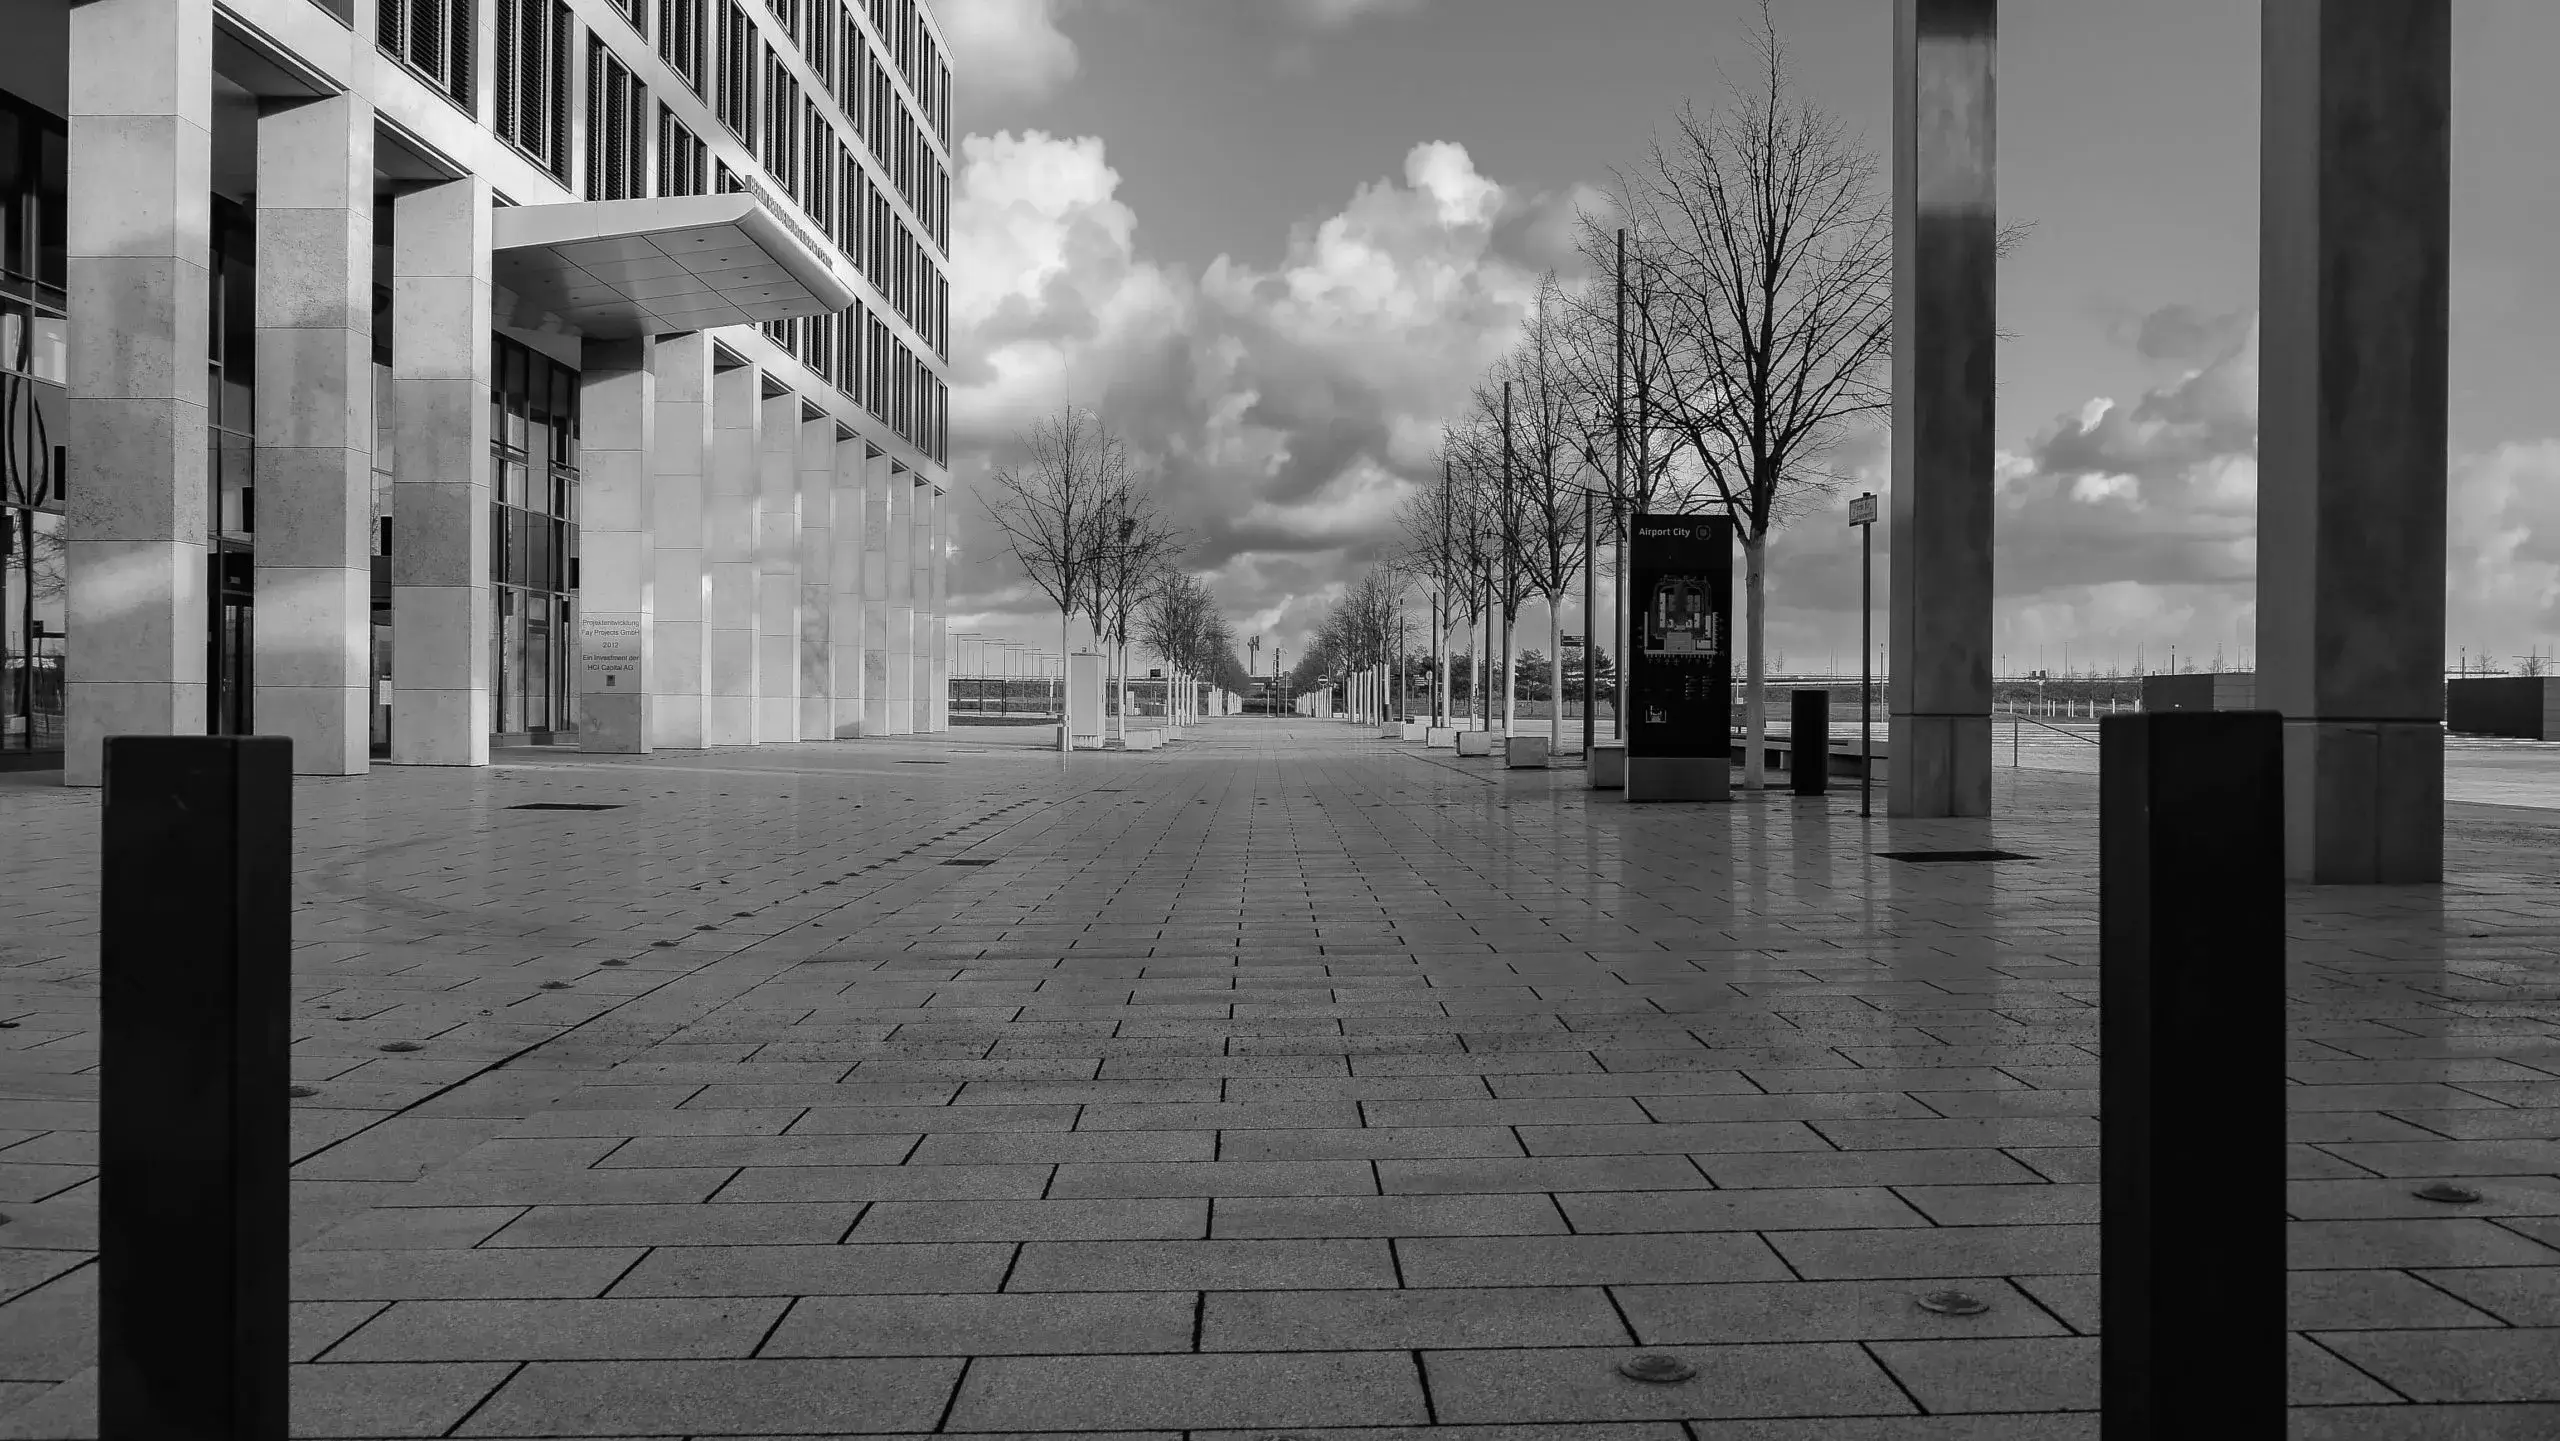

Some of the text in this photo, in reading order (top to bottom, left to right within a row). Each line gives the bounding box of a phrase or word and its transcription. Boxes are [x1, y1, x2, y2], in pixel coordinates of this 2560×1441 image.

[1639, 528, 1690, 538] Airport City
[601, 664, 622, 672] Capital
